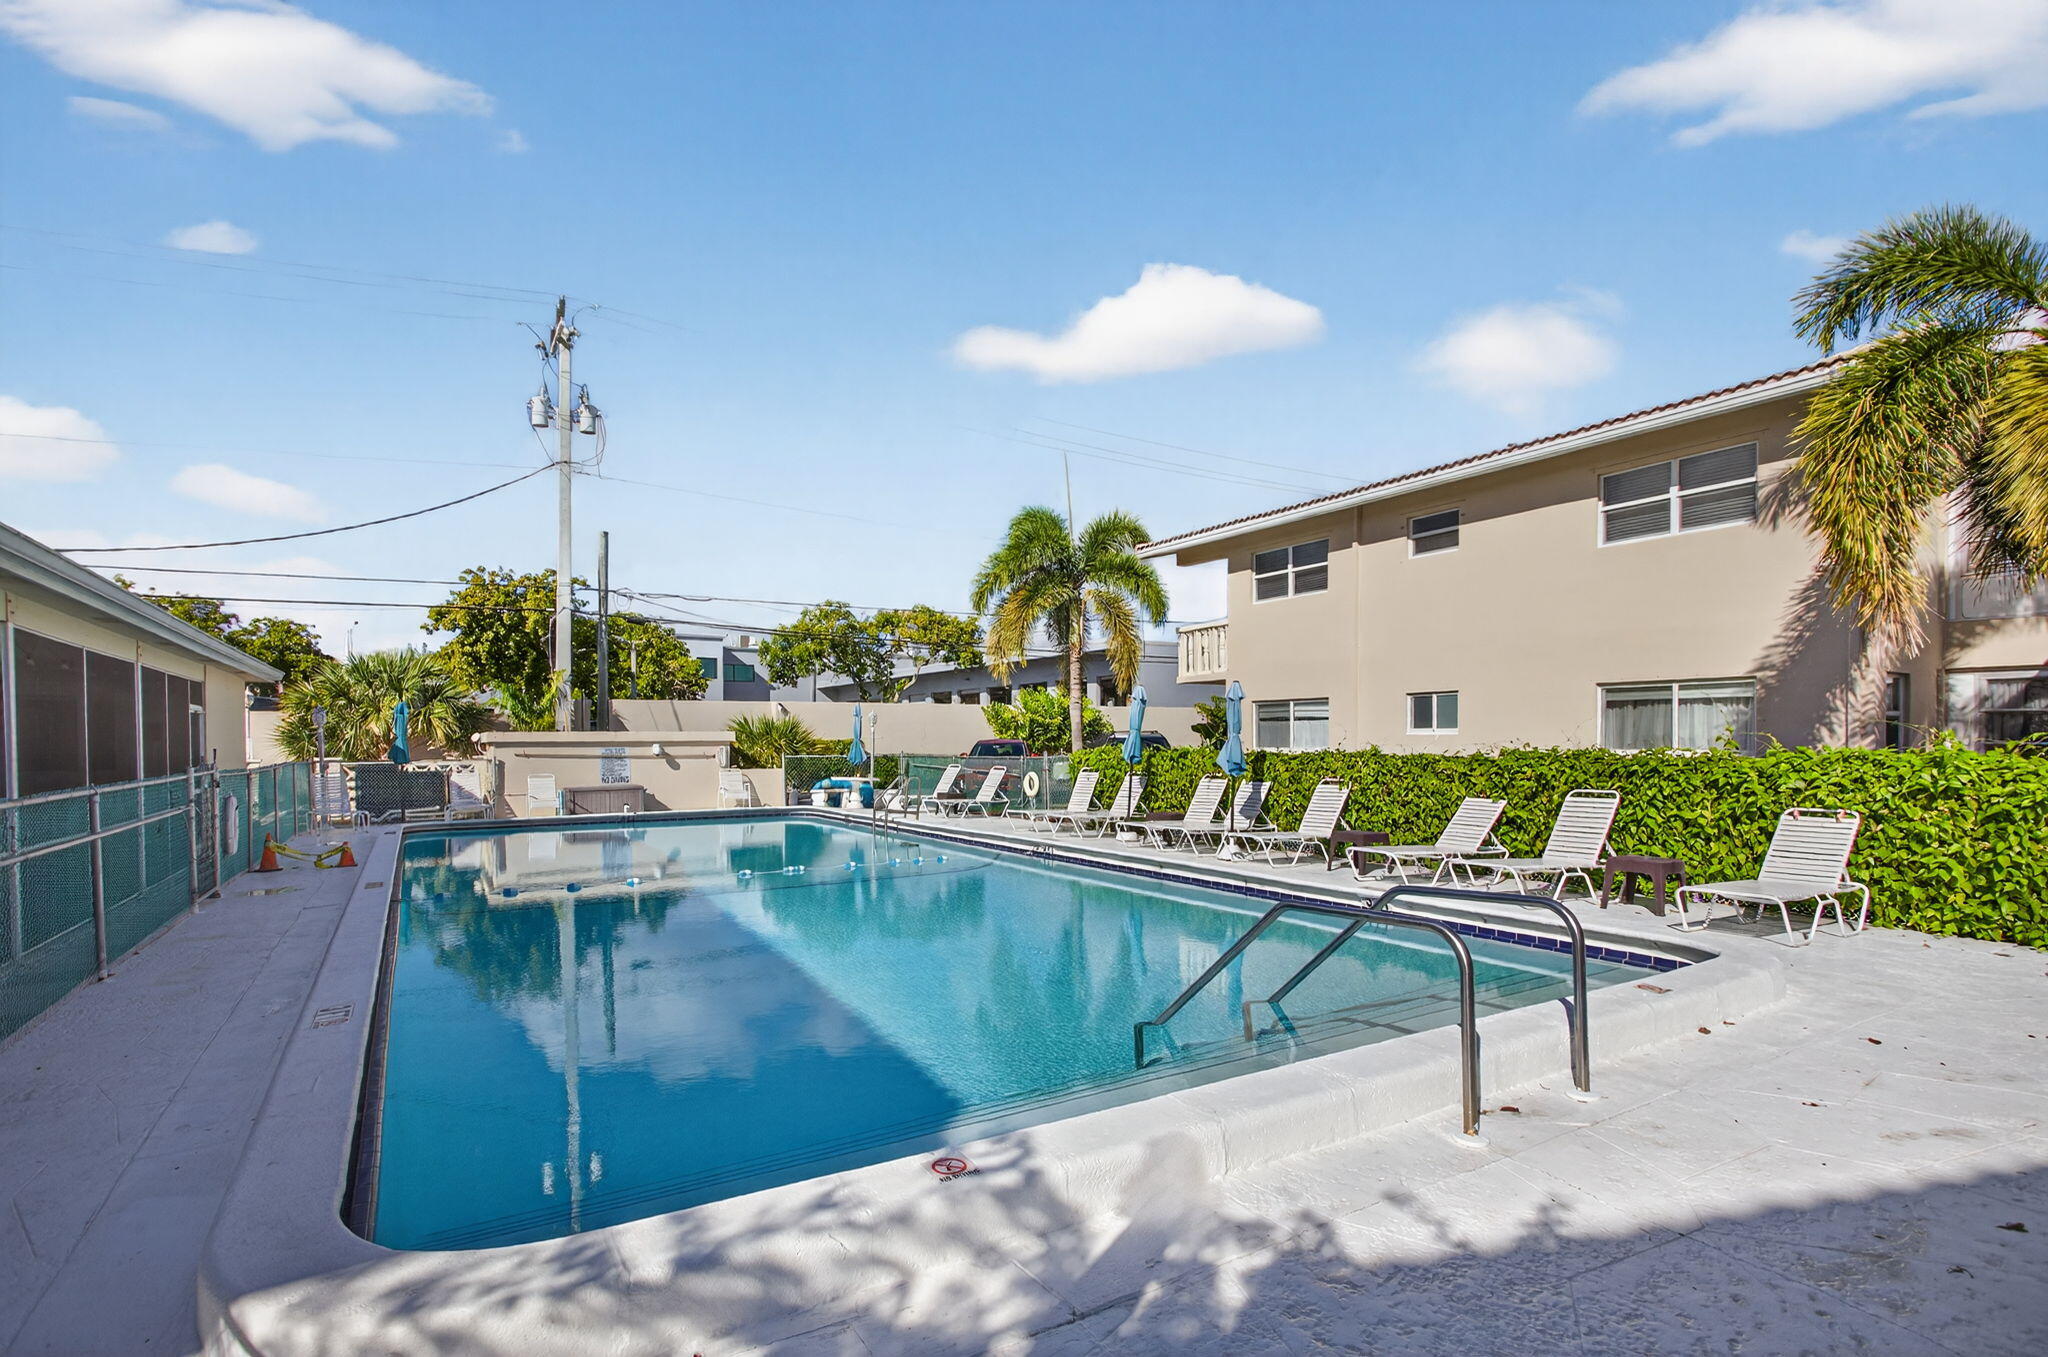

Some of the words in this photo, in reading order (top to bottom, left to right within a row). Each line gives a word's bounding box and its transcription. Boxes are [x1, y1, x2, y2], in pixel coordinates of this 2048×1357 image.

[601, 776, 609, 784] NO
[939, 1175, 952, 1183] NO
[952, 1168, 980, 1180] DIVING
